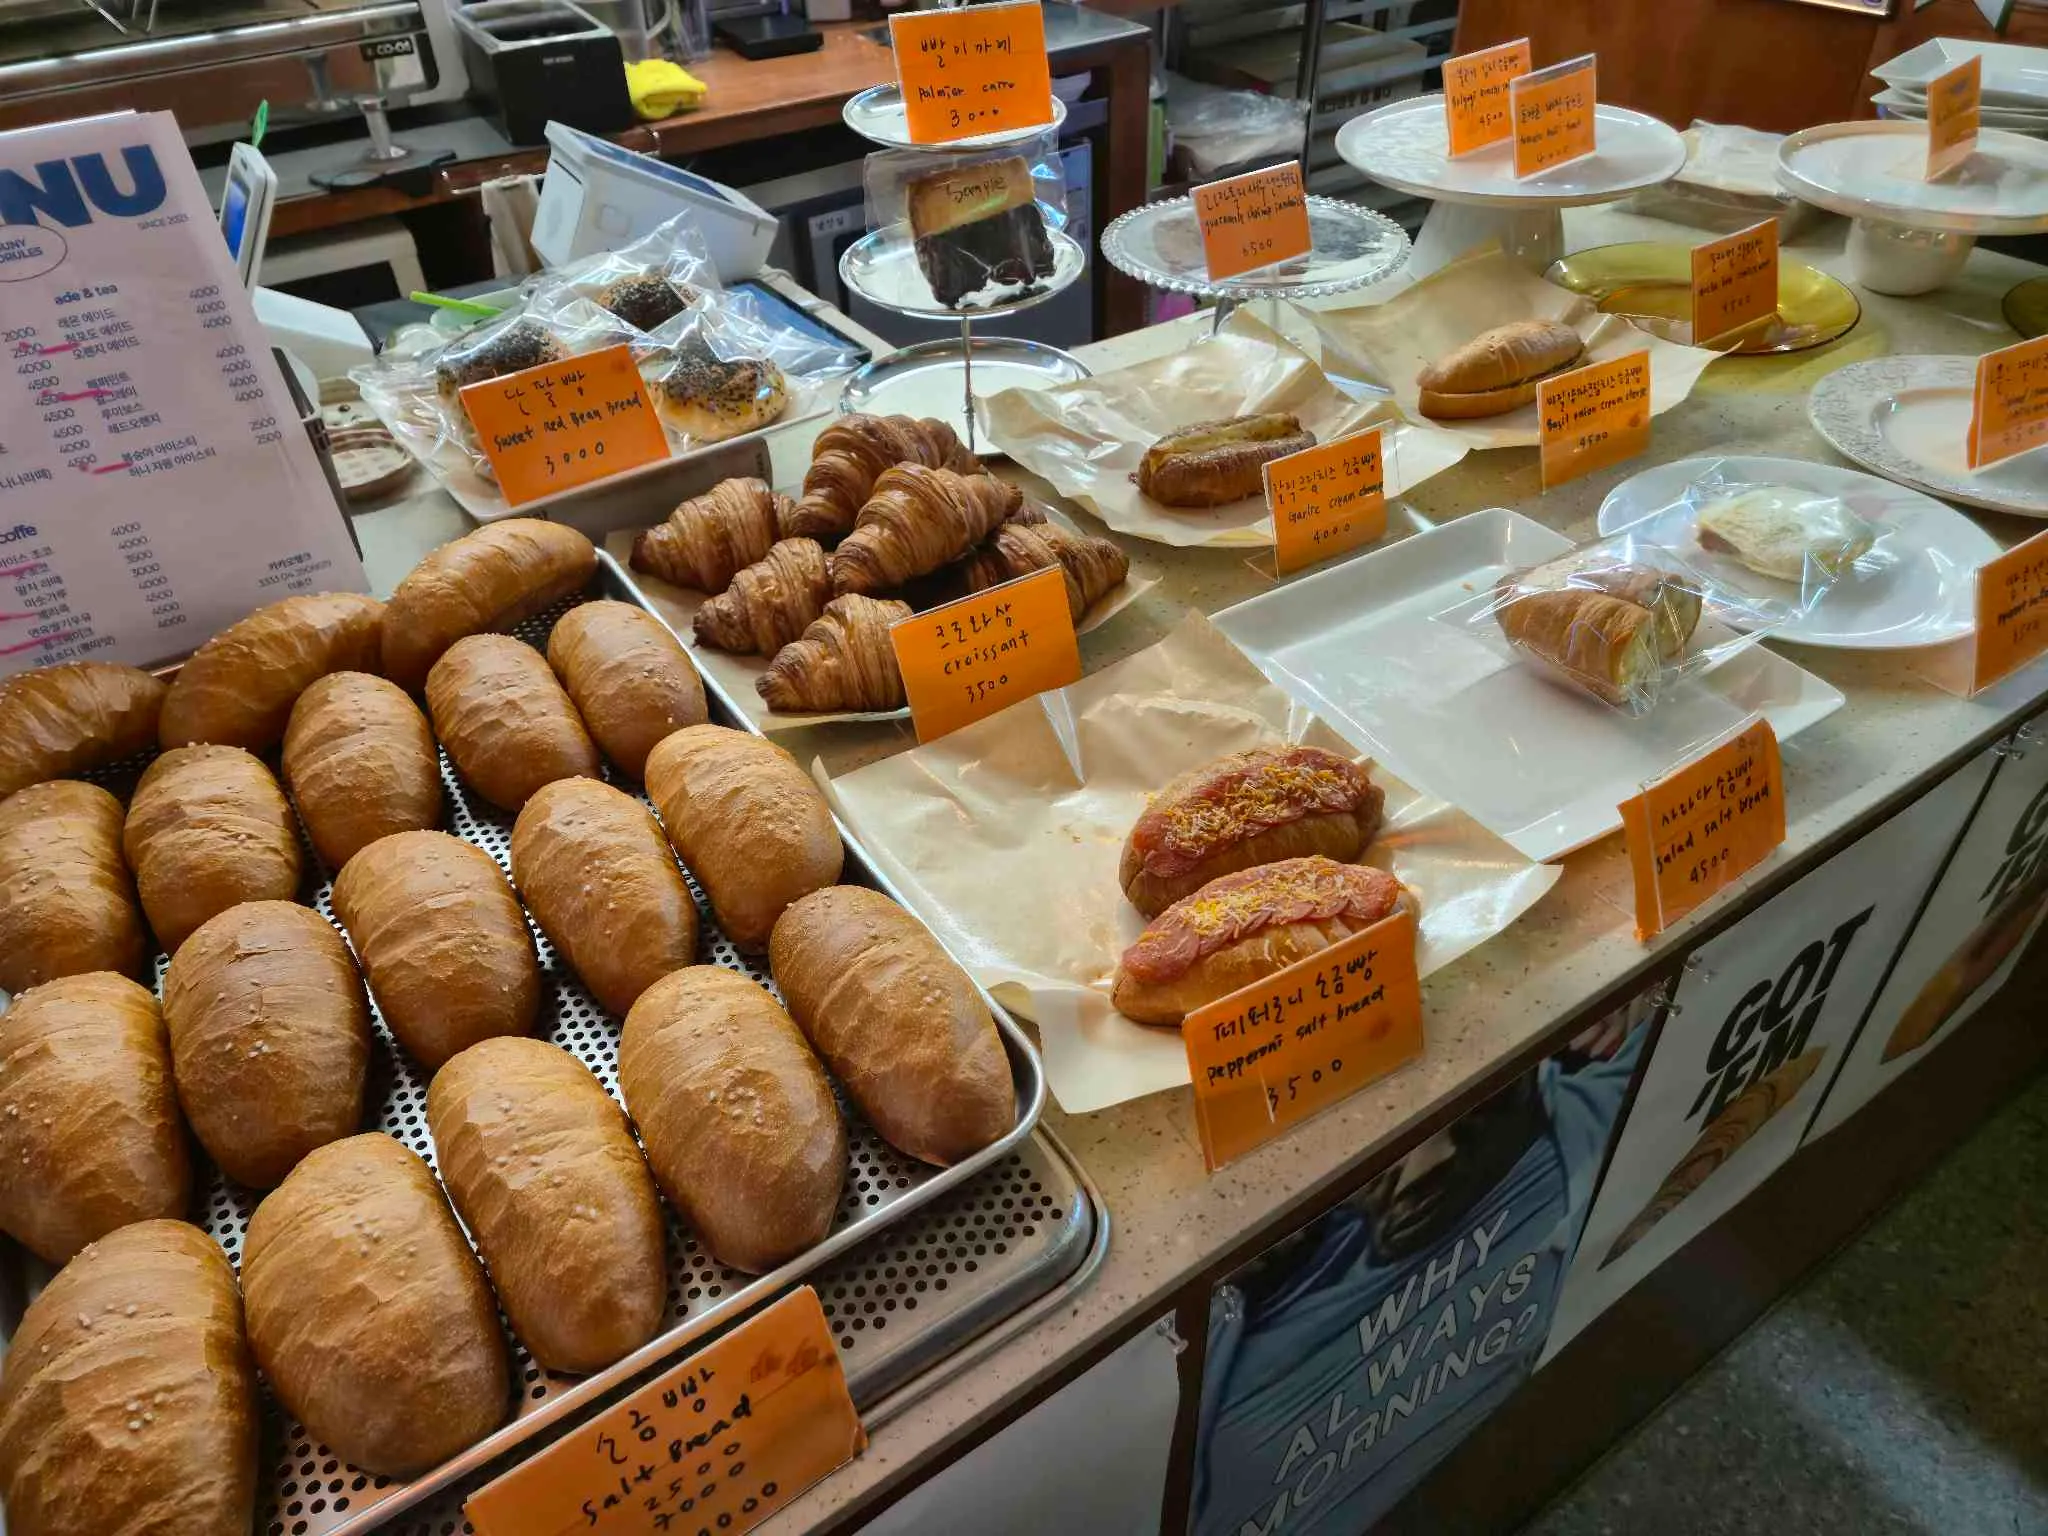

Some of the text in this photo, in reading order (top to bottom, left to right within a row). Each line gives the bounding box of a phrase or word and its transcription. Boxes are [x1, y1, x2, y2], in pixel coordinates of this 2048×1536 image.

[950, 106, 999, 128] 3000
[82, 288, 94, 299] &
[94, 284, 118, 297] tea
[189, 285, 219, 299] 4000
[196, 300, 226, 314] 4000
[202, 315, 232, 329] 4000
[18, 359, 51, 374] 4000
[494, 424, 535, 453] Sweet
[544, 441, 605, 476] 3000
[1312, 521, 1352, 545] 4000
[965, 674, 1008, 704] 3500
[1689, 847, 1730, 883] 4500
[1315, 949, 1378, 999] 소금빵
[1705, 903, 1877, 1075] GOT
[1267, 1058, 1343, 1113] 3500
[1357, 1207, 1511, 1355] WHY
[596, 1366, 715, 1465] 소금빵
[643, 1442, 742, 1511] 2500
